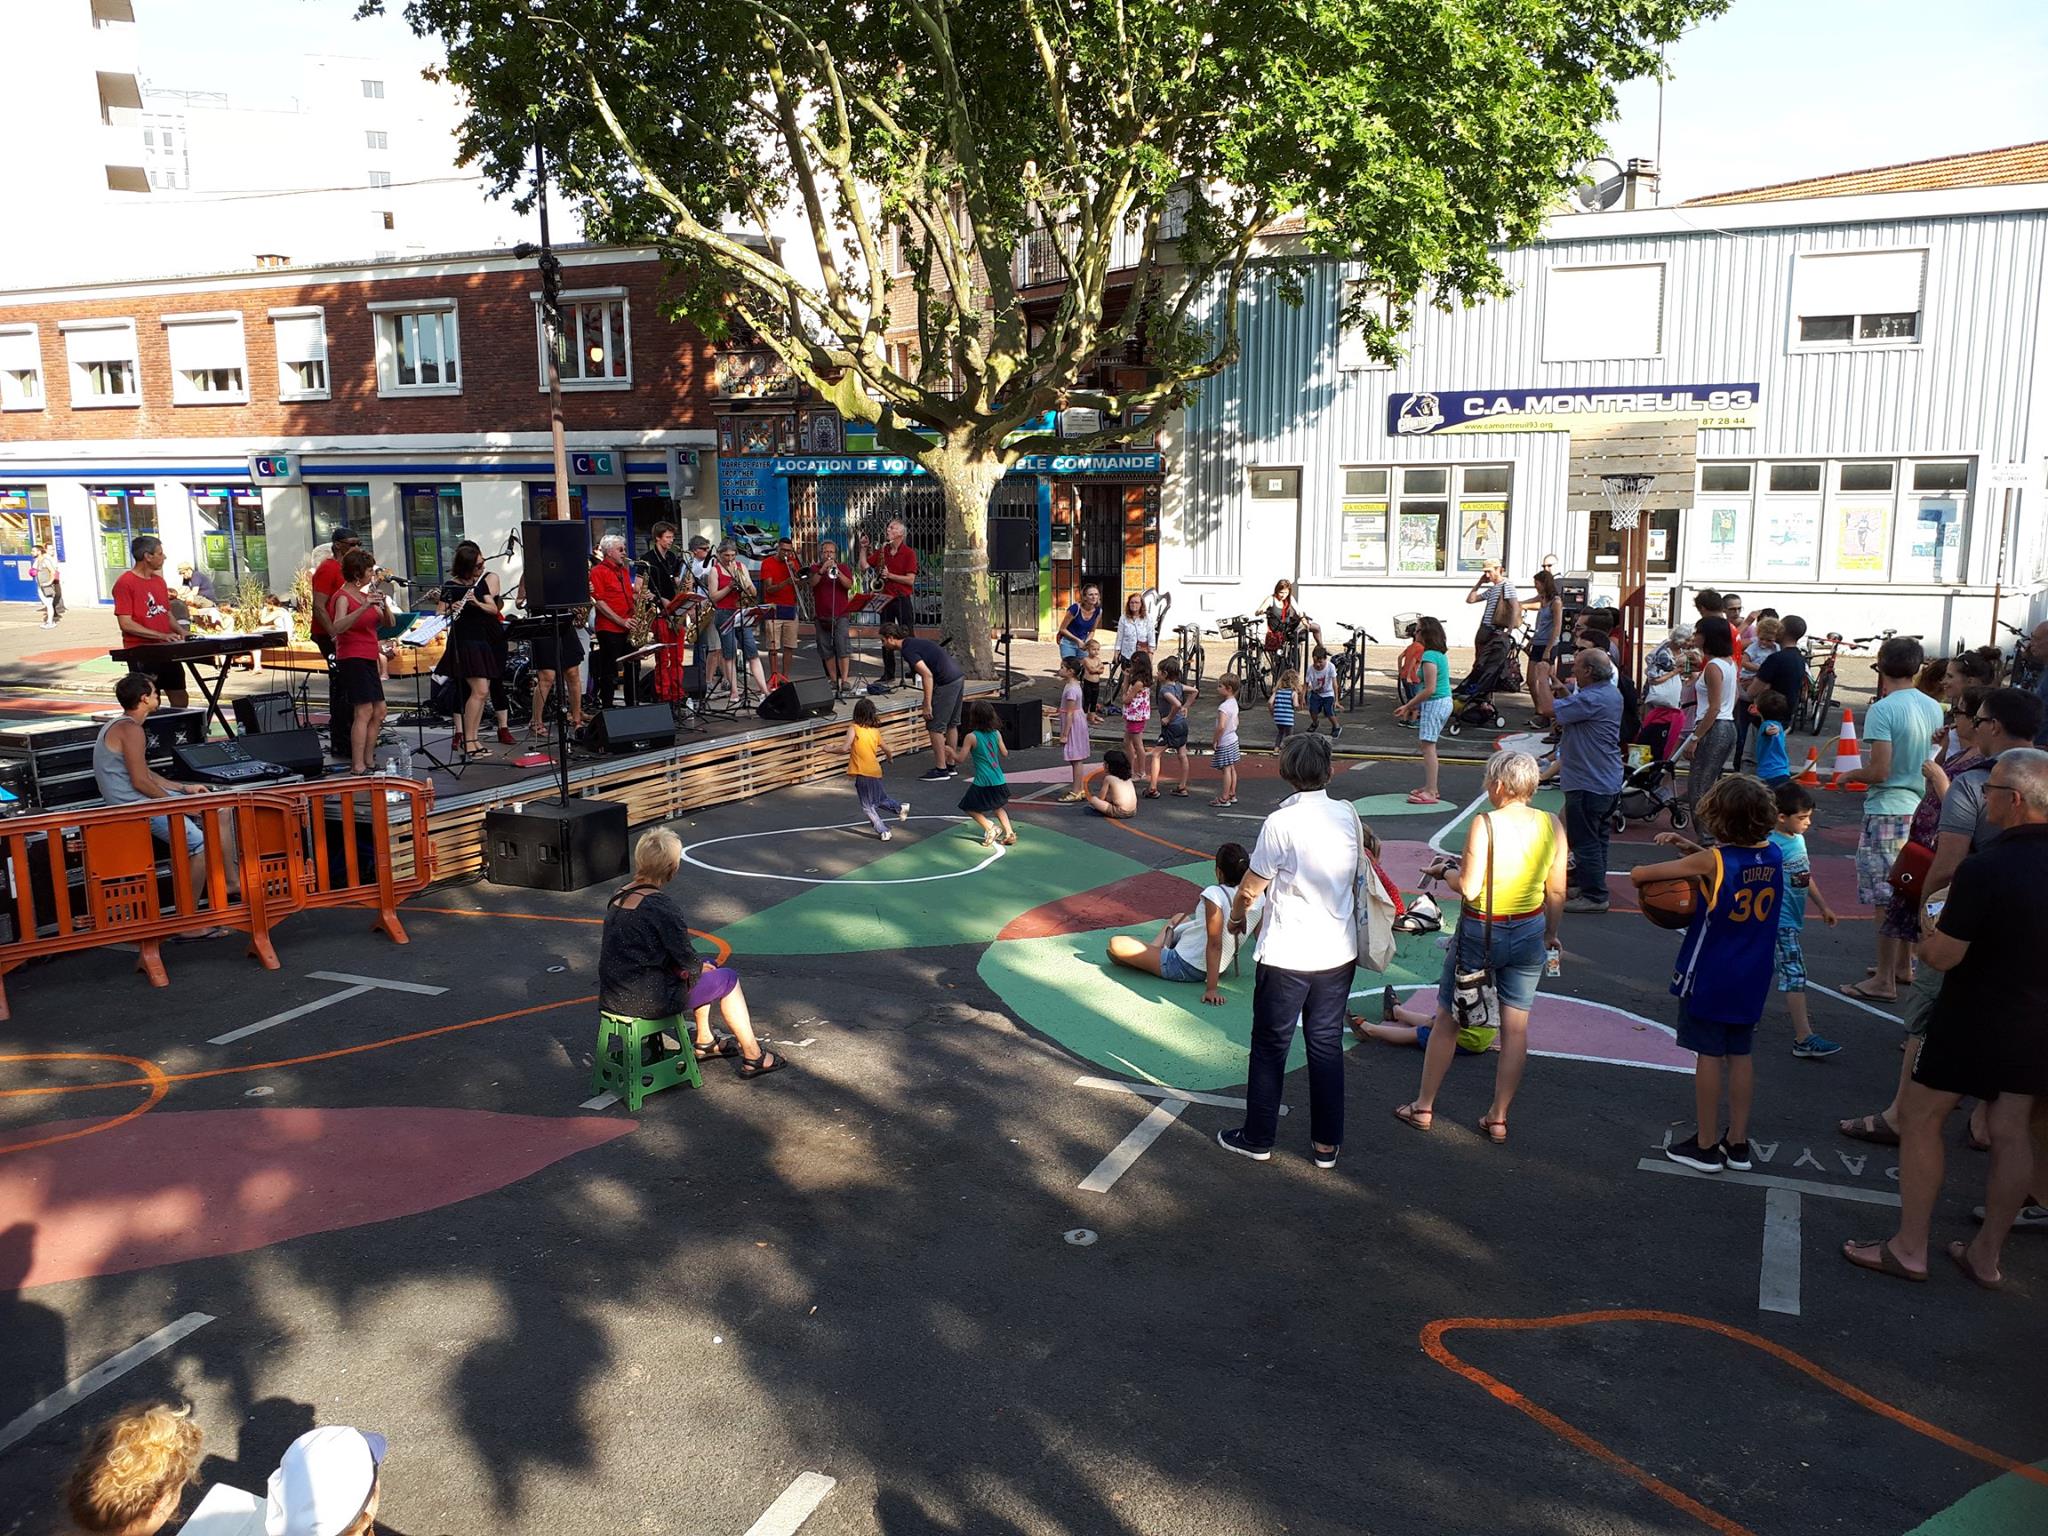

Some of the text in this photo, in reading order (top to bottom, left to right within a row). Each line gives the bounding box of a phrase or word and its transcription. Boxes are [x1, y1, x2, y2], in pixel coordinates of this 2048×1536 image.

[1463, 390, 1752, 416] C.A. MONTREUIL 93
[1702, 417, 1714, 425] 87
[1718, 417, 1730, 425] 28
[258, 460, 288, 474] CIC
[576, 457, 609, 472] CIC
[777, 459, 851, 471] LOCATION
[857, 459, 877, 471] DE
[882, 459, 917, 471] VOIT
[1052, 456, 1155, 470] COMMANDE
[1742, 866, 1776, 884] CURRY
[1728, 886, 1776, 922] 30
